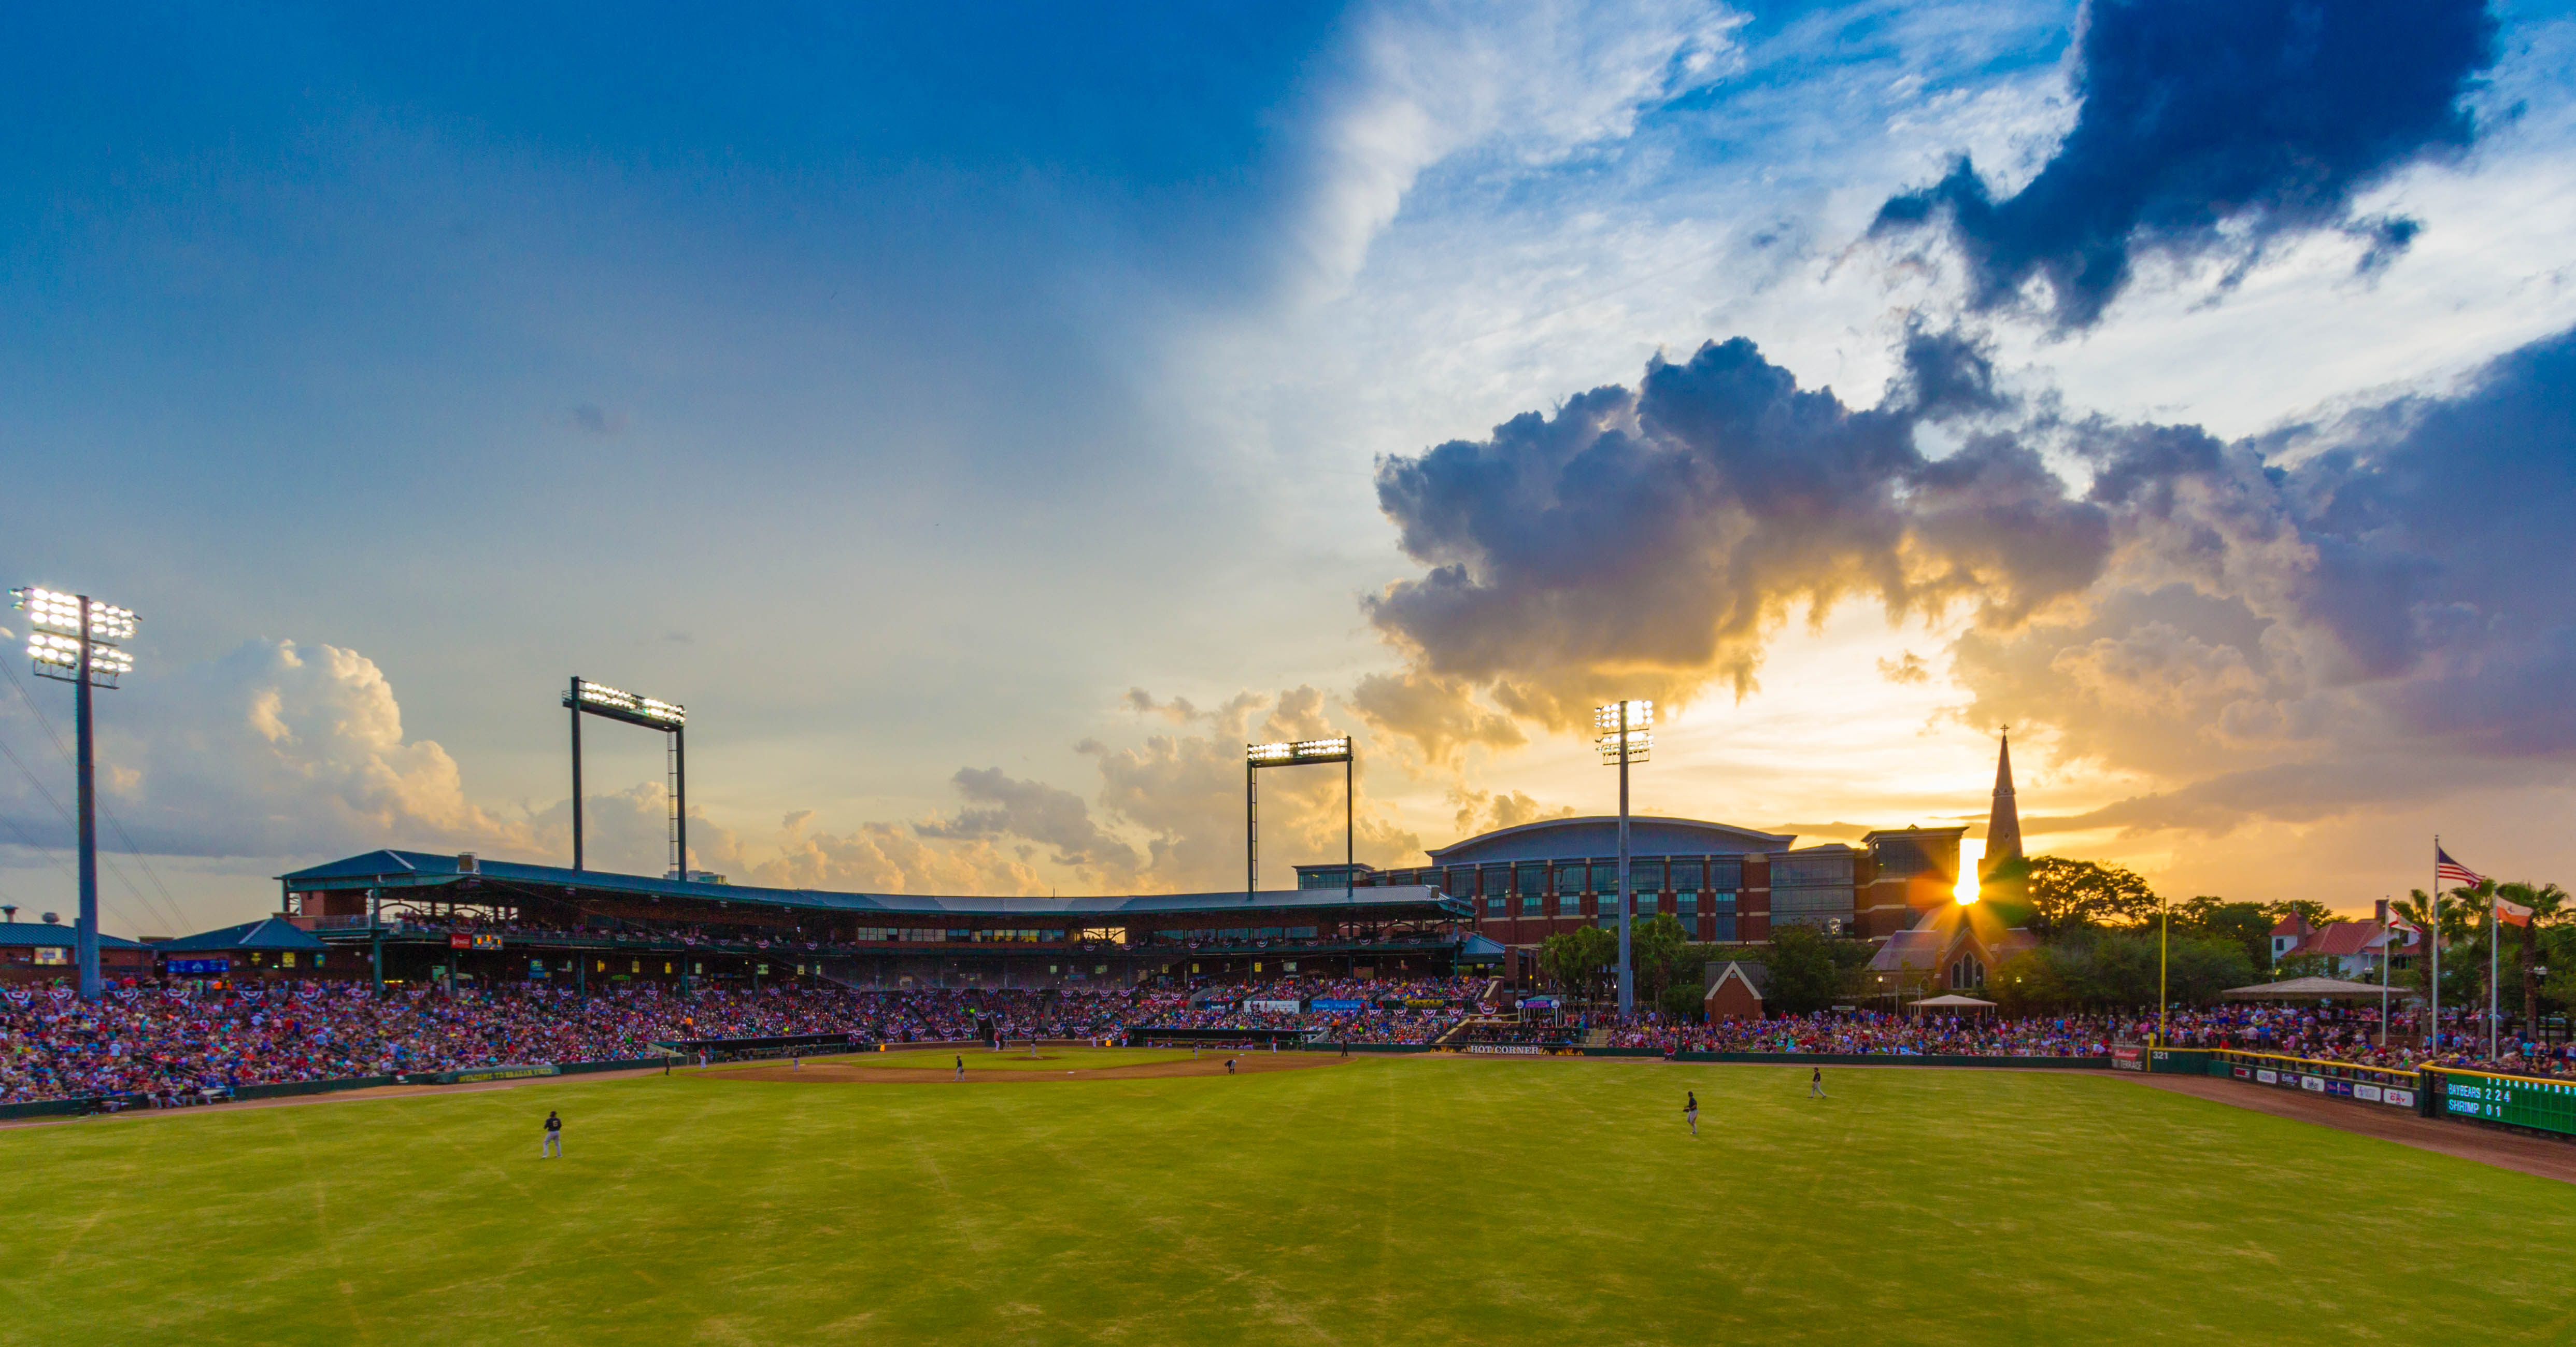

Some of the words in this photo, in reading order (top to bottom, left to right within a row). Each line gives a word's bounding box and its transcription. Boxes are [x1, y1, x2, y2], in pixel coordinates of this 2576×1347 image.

[1471, 1045, 1492, 1054] HOT
[1495, 1045, 1539, 1054] CORNER
[2153, 1051, 2168, 1059] 321
[2448, 1083, 2481, 1099] BAYBEARS
[2485, 1088, 2492, 1100] 2
[2495, 1089, 2502, 1101] 2
[2503, 1090, 2511, 1103] 4
[2564, 1086, 2570, 1095] 9
[2449, 1099, 2480, 1114] SHRIMP
[2486, 1104, 2492, 1116] 0
[2496, 1105, 2501, 1117] 1
